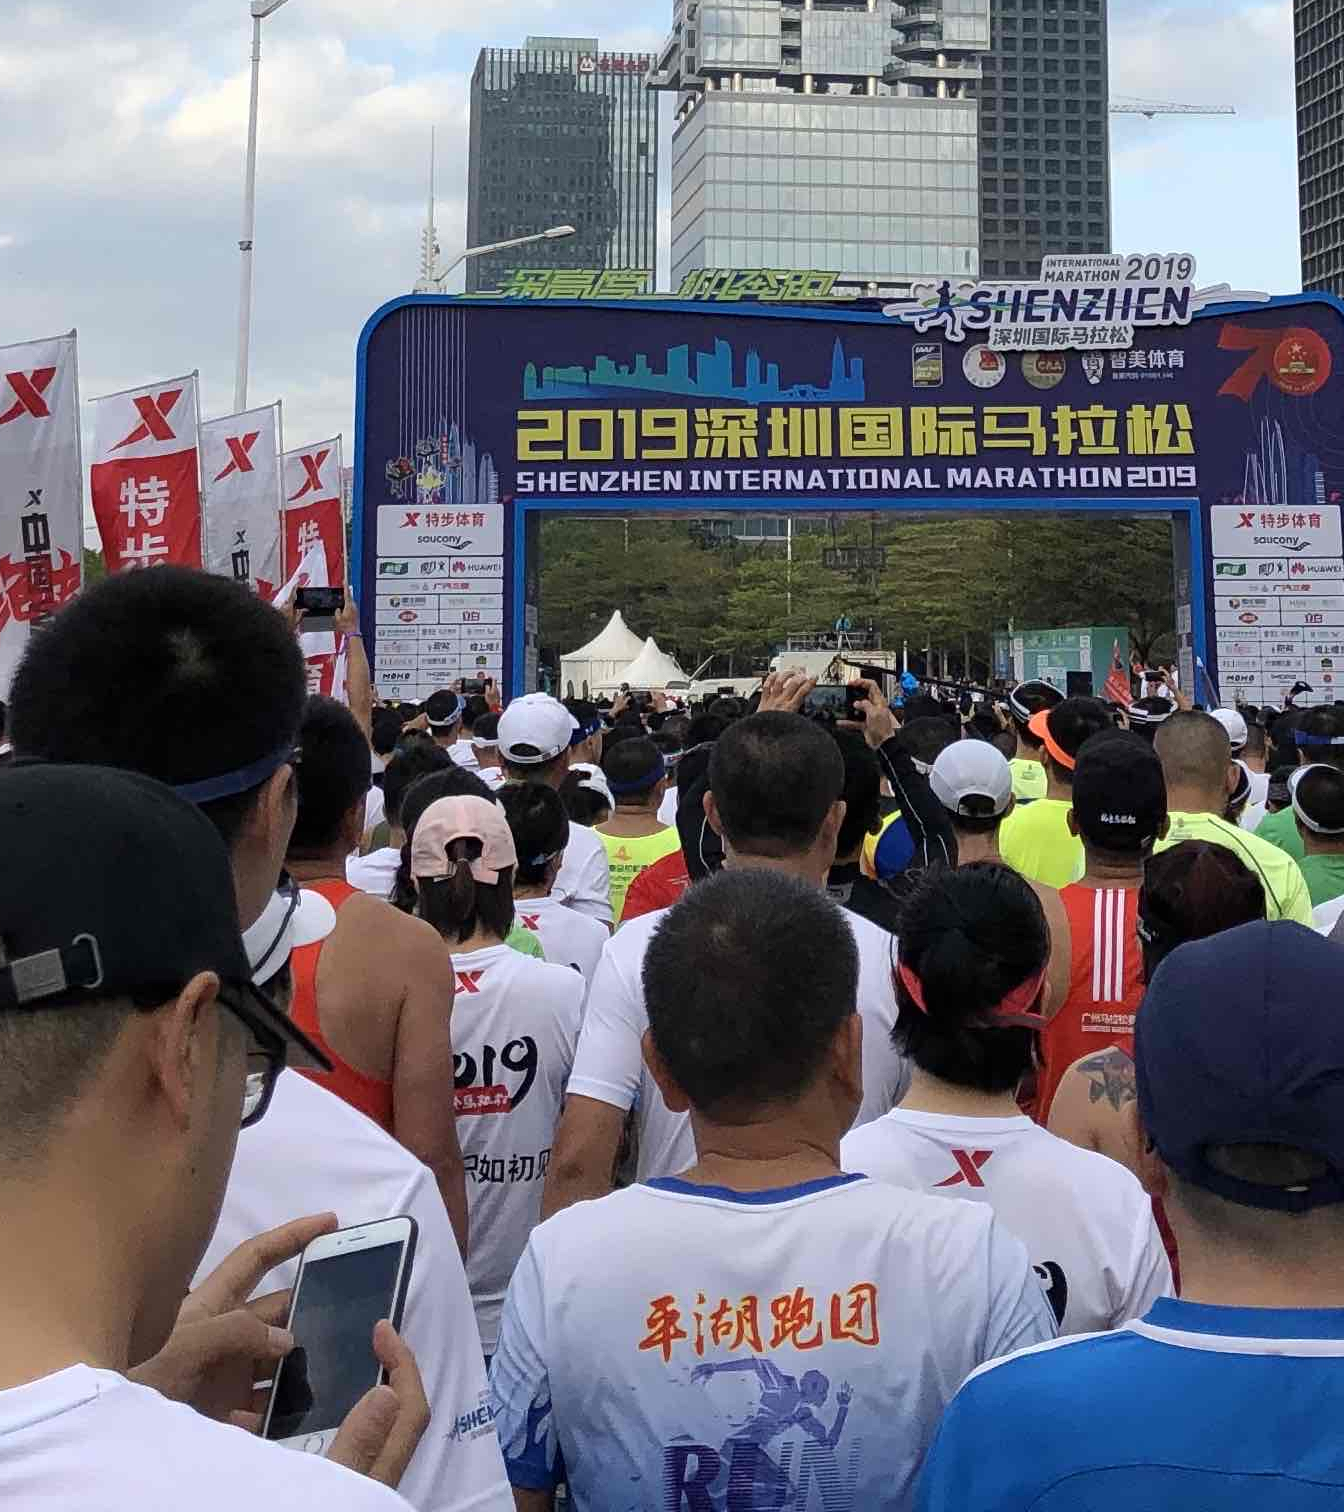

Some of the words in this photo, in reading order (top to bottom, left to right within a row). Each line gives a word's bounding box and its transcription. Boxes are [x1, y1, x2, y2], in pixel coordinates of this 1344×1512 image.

[1044, 269, 1121, 283] MARATHON
[1045, 257, 1121, 269] INTERNATIONAL
[1125, 256, 1193, 281] 2019
[967, 286, 1192, 325] SHENZHEN
[992, 325, 1129, 346] 深圳国际马拉松
[1111, 349, 1185, 369] 智美体育
[516, 404, 1196, 461] 2019深圳国际马拉松
[516, 469, 683, 493] SHENZHEN
[688, 467, 941, 492] INTERNATIONAL
[946, 466, 1122, 490] MARATHON
[1126, 465, 1197, 489] 2019
[425, 512, 486, 528] 特步体育
[1260, 512, 1322, 529] 特步体育
[417, 534, 462, 545] saucony
[1253, 535, 1300, 546] saucony
[1307, 565, 1342, 574] HUAWEI
[637, 1282, 882, 1363] 平湖跑团
